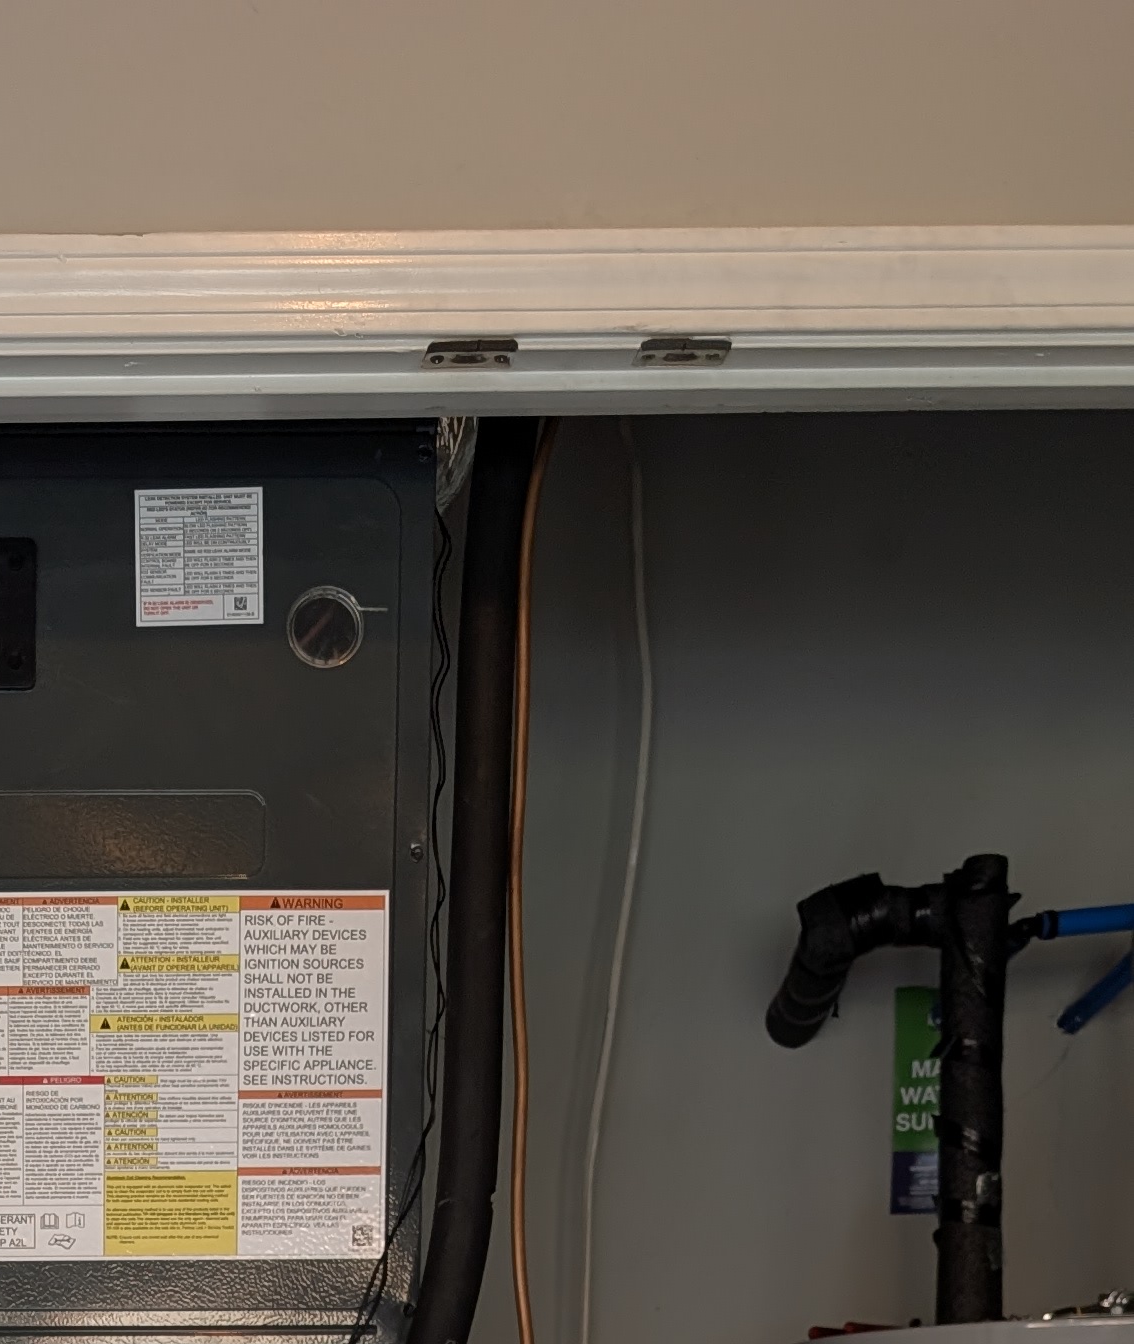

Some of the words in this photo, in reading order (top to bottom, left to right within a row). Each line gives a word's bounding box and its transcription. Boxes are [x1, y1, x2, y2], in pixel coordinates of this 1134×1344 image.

[282, 898, 344, 909] WARNING
[244, 915, 273, 926] RISK
[277, 915, 293, 926] OF
[298, 915, 326, 926] FIRE
[244, 930, 309, 941] AUXILIARY
[312, 930, 367, 941] DEVICES
[244, 944, 286, 955] WHICH
[290, 944, 316, 955] MAY
[321, 944, 336, 955] BE
[244, 959, 299, 969] IGNITION
[303, 959, 364, 969] SOURCES
[244, 973, 283, 984] SHALL
[287, 973, 313, 984] NOT
[317, 973, 333, 984] BE
[244, 988, 311, 998] INSTALLED
[315, 988, 327, 998] IN
[331, 988, 355, 998] THE
[244, 1002, 321, 1014] DUCTWORK,
[324, 1002, 368, 1013] OTHER
[244, 1017, 277, 1027] THAN
[281, 1017, 345, 1027] AUXILIARY
[244, 1031, 297, 1042] DEVICES
[302, 1031, 345, 1042] LISTED
[349, 1031, 374, 1042] FOR
[244, 1046, 268, 1056] USE
[272, 1046, 305, 1056] WITH
[309, 1046, 332, 1056] THE
[243, 1060, 300, 1071] SPECIFIC
[304, 1060, 377, 1071] APPLIANCE.
[243, 1075, 267, 1085] SEE
[272, 1075, 367, 1085] INSTRUCTIONS.
[9, 1239, 27, 1247] A2L
